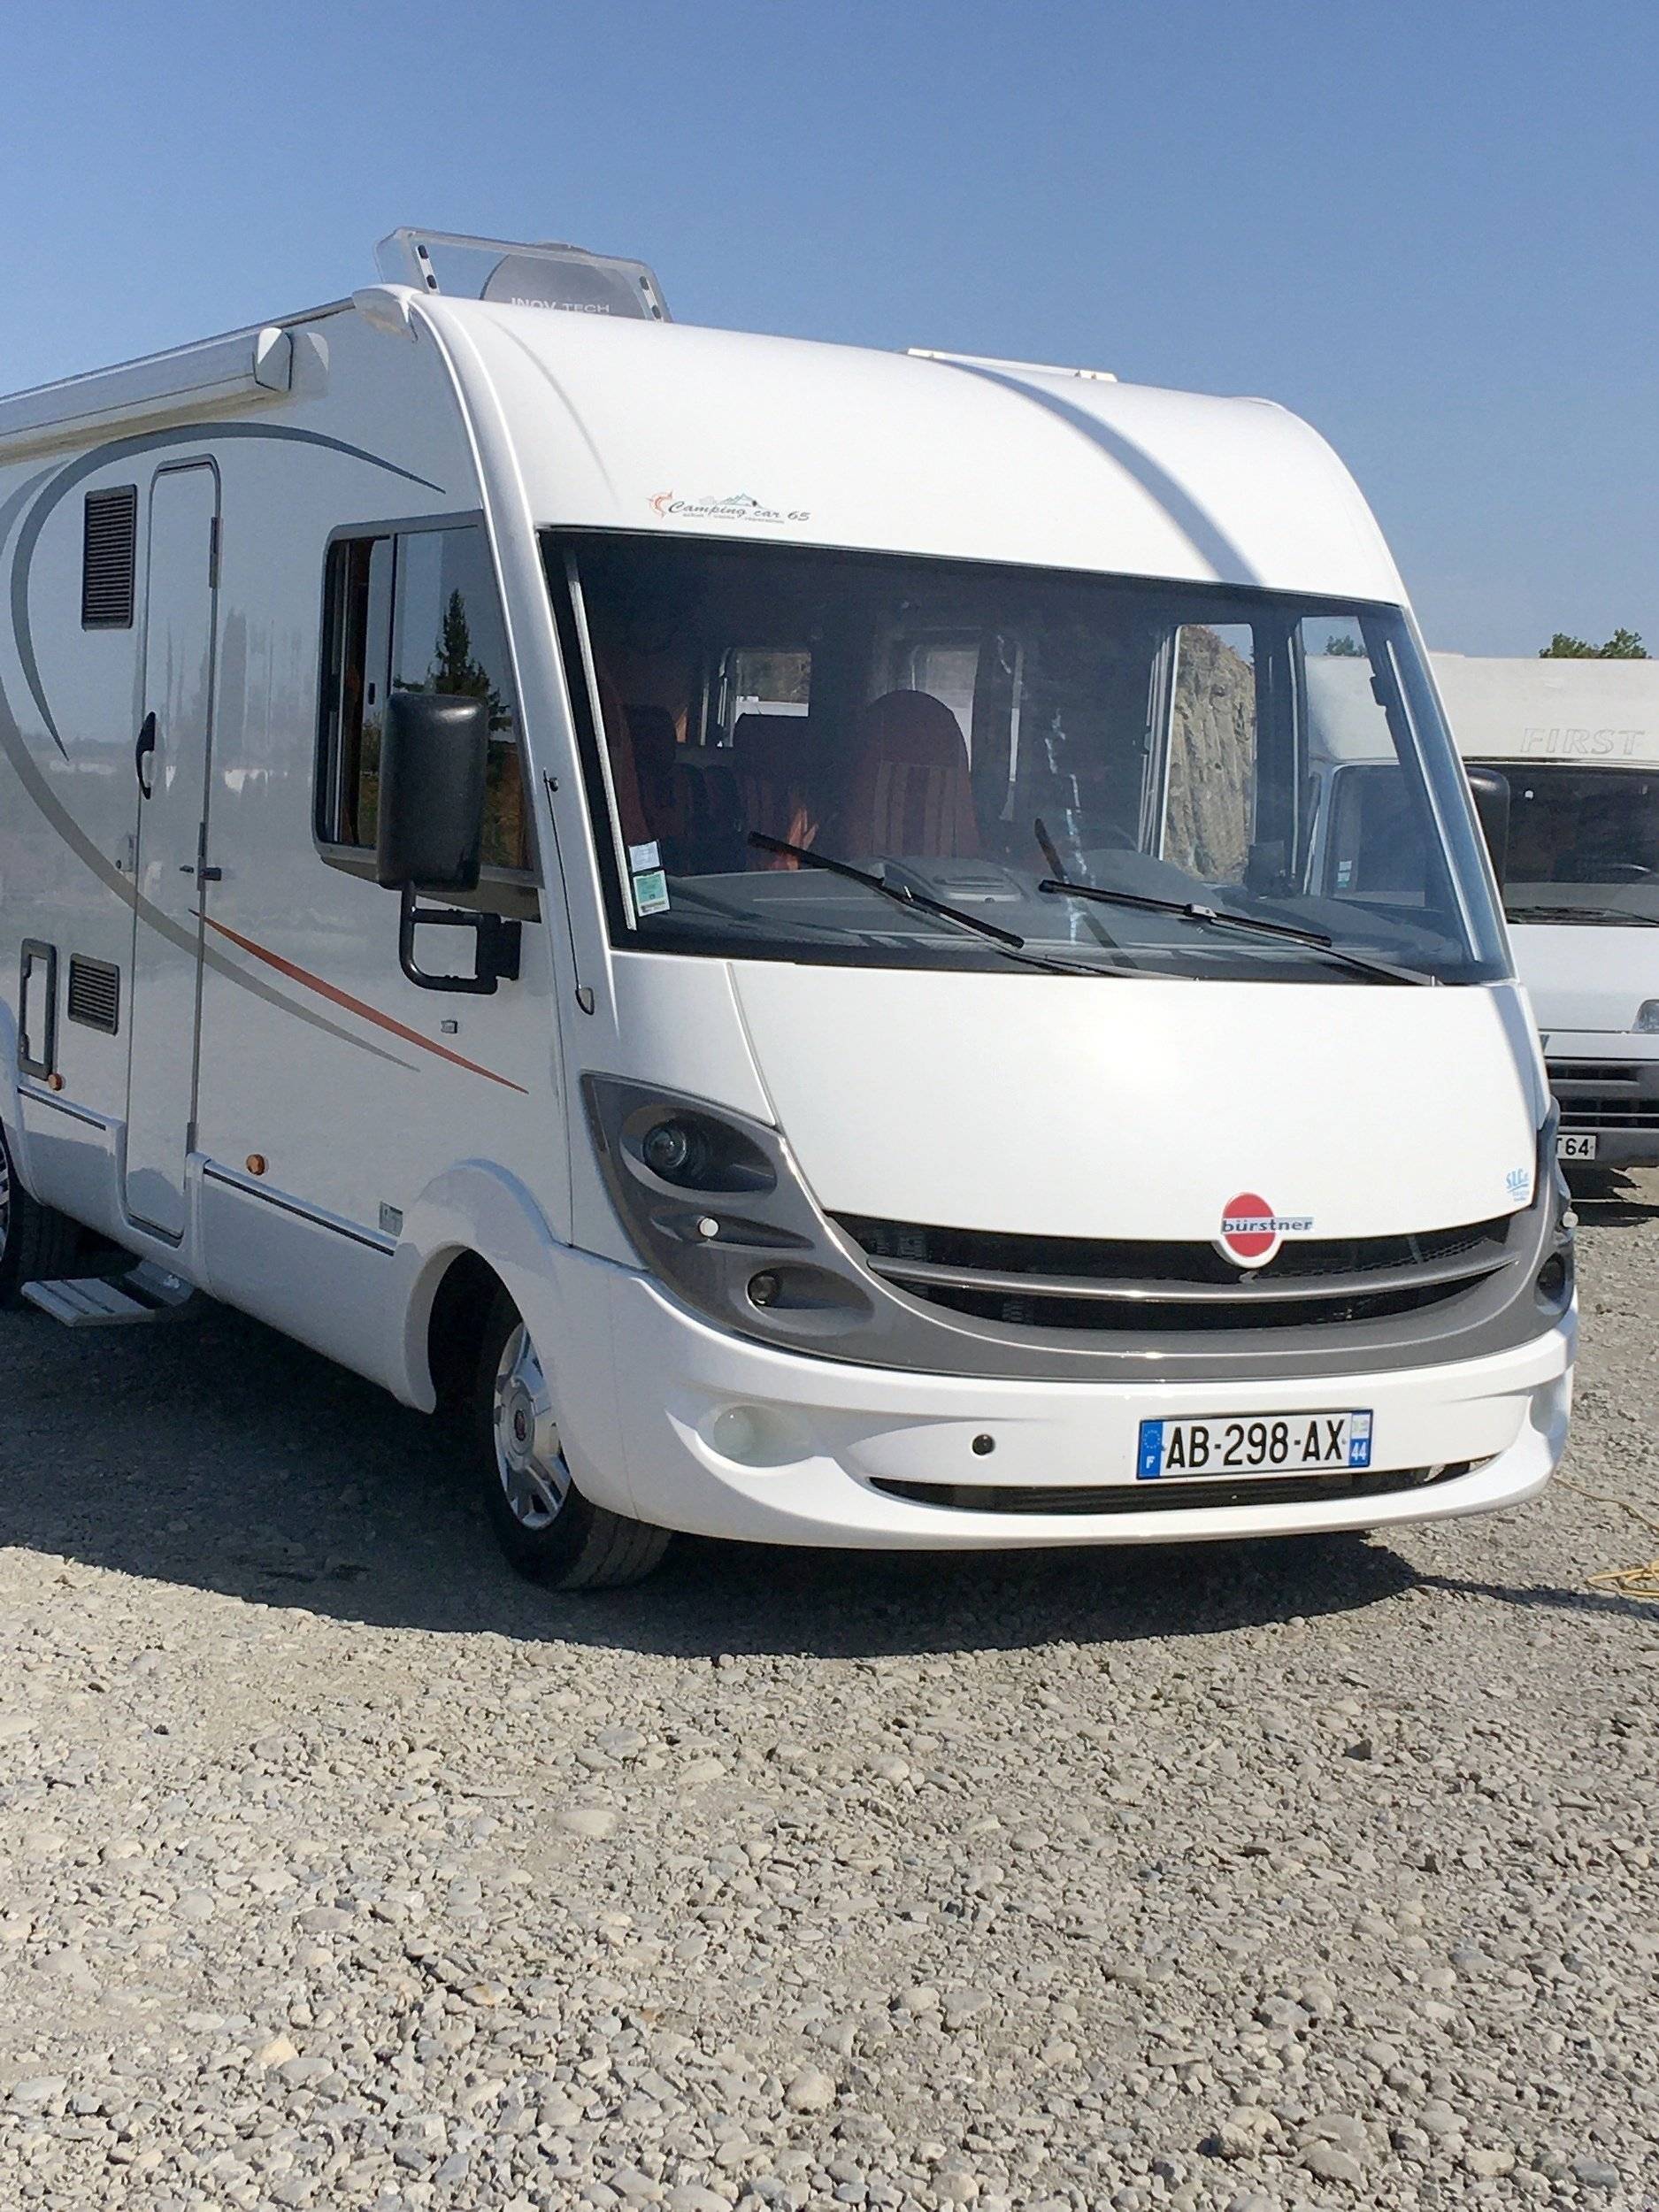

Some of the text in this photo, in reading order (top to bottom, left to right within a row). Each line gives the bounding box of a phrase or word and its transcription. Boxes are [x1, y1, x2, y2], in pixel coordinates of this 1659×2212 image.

[562, 303, 610, 313] TECH
[668, 501, 746, 518] Camping
[753, 509, 780, 518] car
[787, 511, 811, 522] 65
[1520, 727, 1646, 756] FIRST
[1221, 1218, 1313, 1233] bürstner
[1145, 1418, 1368, 1470] F AB-298-AX 44
